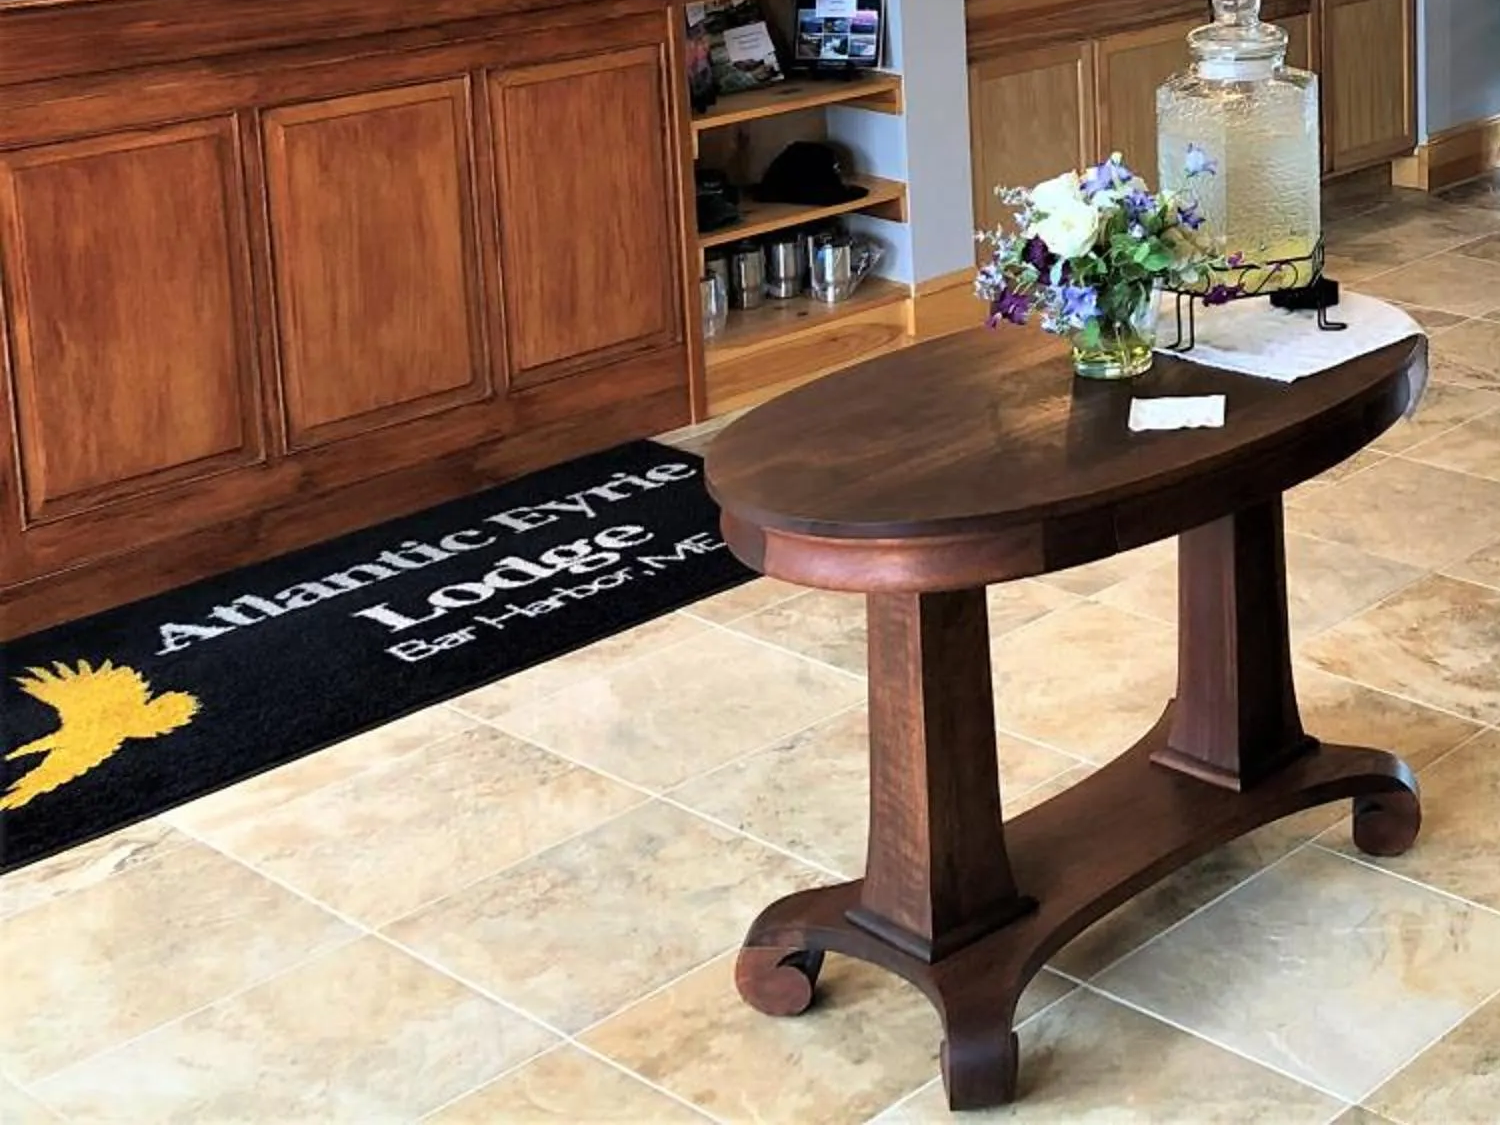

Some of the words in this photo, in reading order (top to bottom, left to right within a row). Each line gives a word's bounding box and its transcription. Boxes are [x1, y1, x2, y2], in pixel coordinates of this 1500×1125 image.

[154, 529, 498, 657] Atlantic
[483, 462, 697, 534] Eyrie
[352, 525, 655, 633] Lodge
[385, 626, 477, 662] Bar
